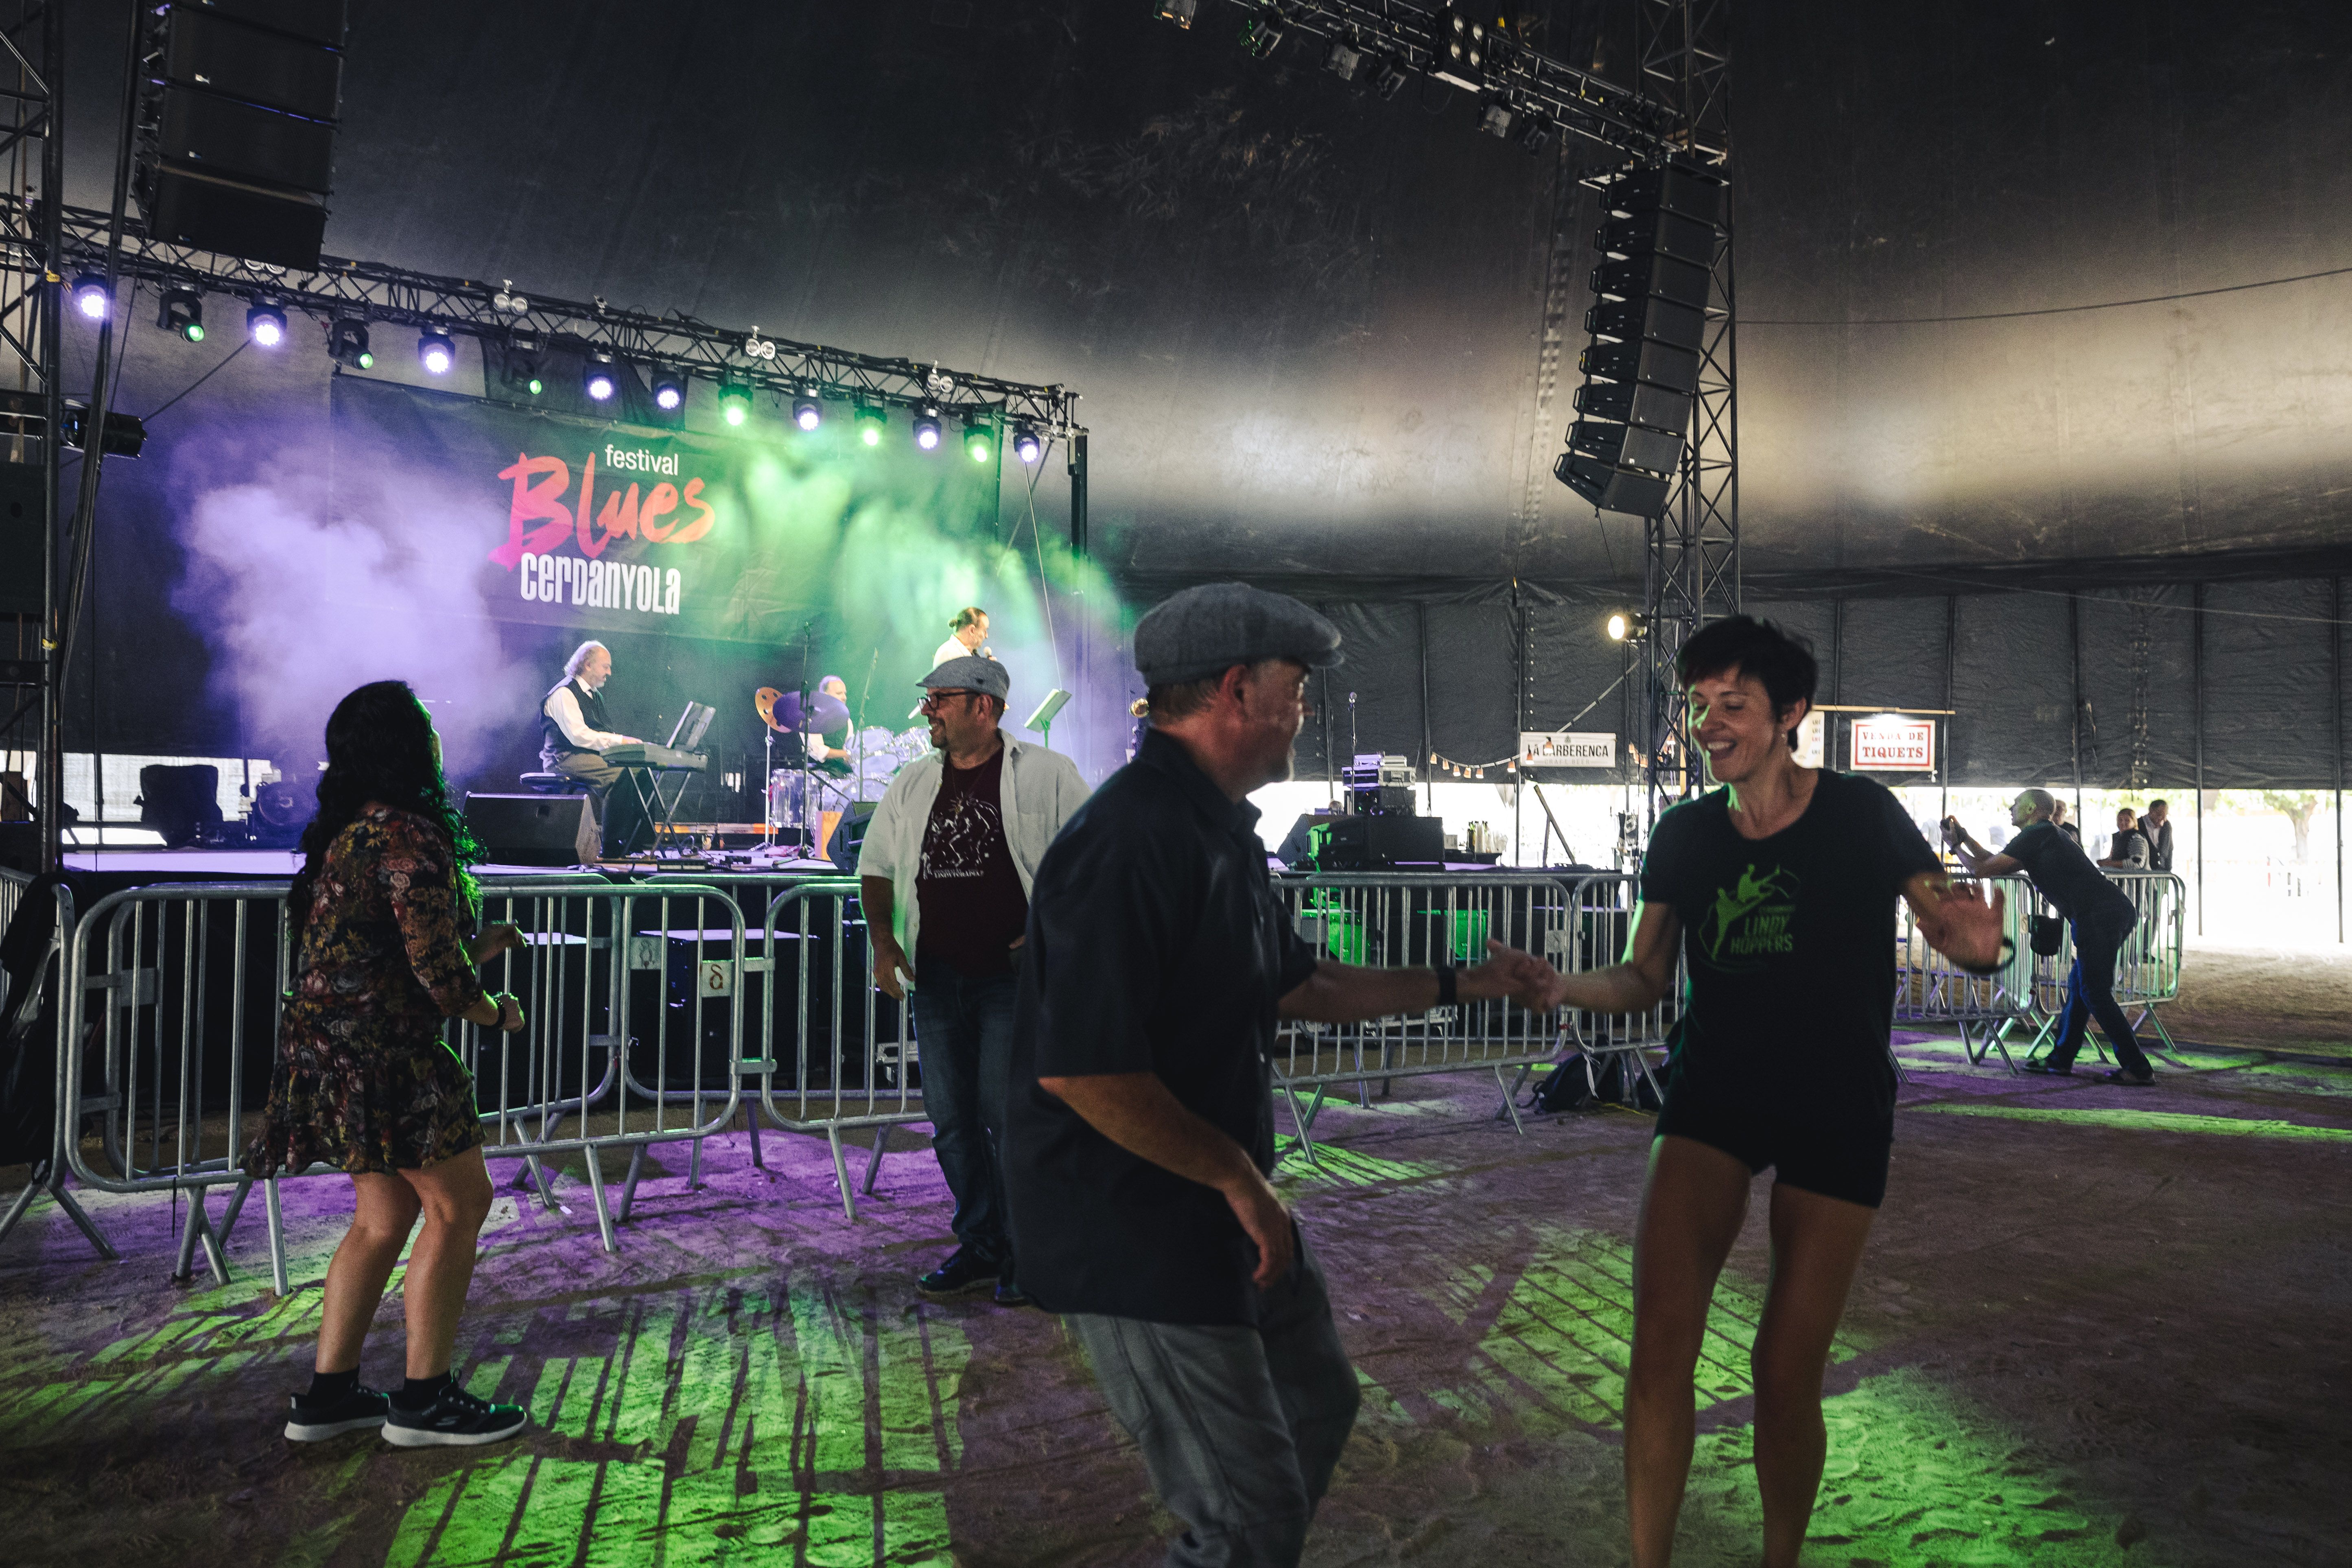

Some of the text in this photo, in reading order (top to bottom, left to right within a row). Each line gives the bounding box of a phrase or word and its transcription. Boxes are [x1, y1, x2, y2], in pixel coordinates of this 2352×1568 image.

[605, 444, 678, 476] festival
[488, 451, 715, 571] Blues
[1909, 732, 1924, 740] DE
[1862, 747, 1923, 758] TIQUETS
